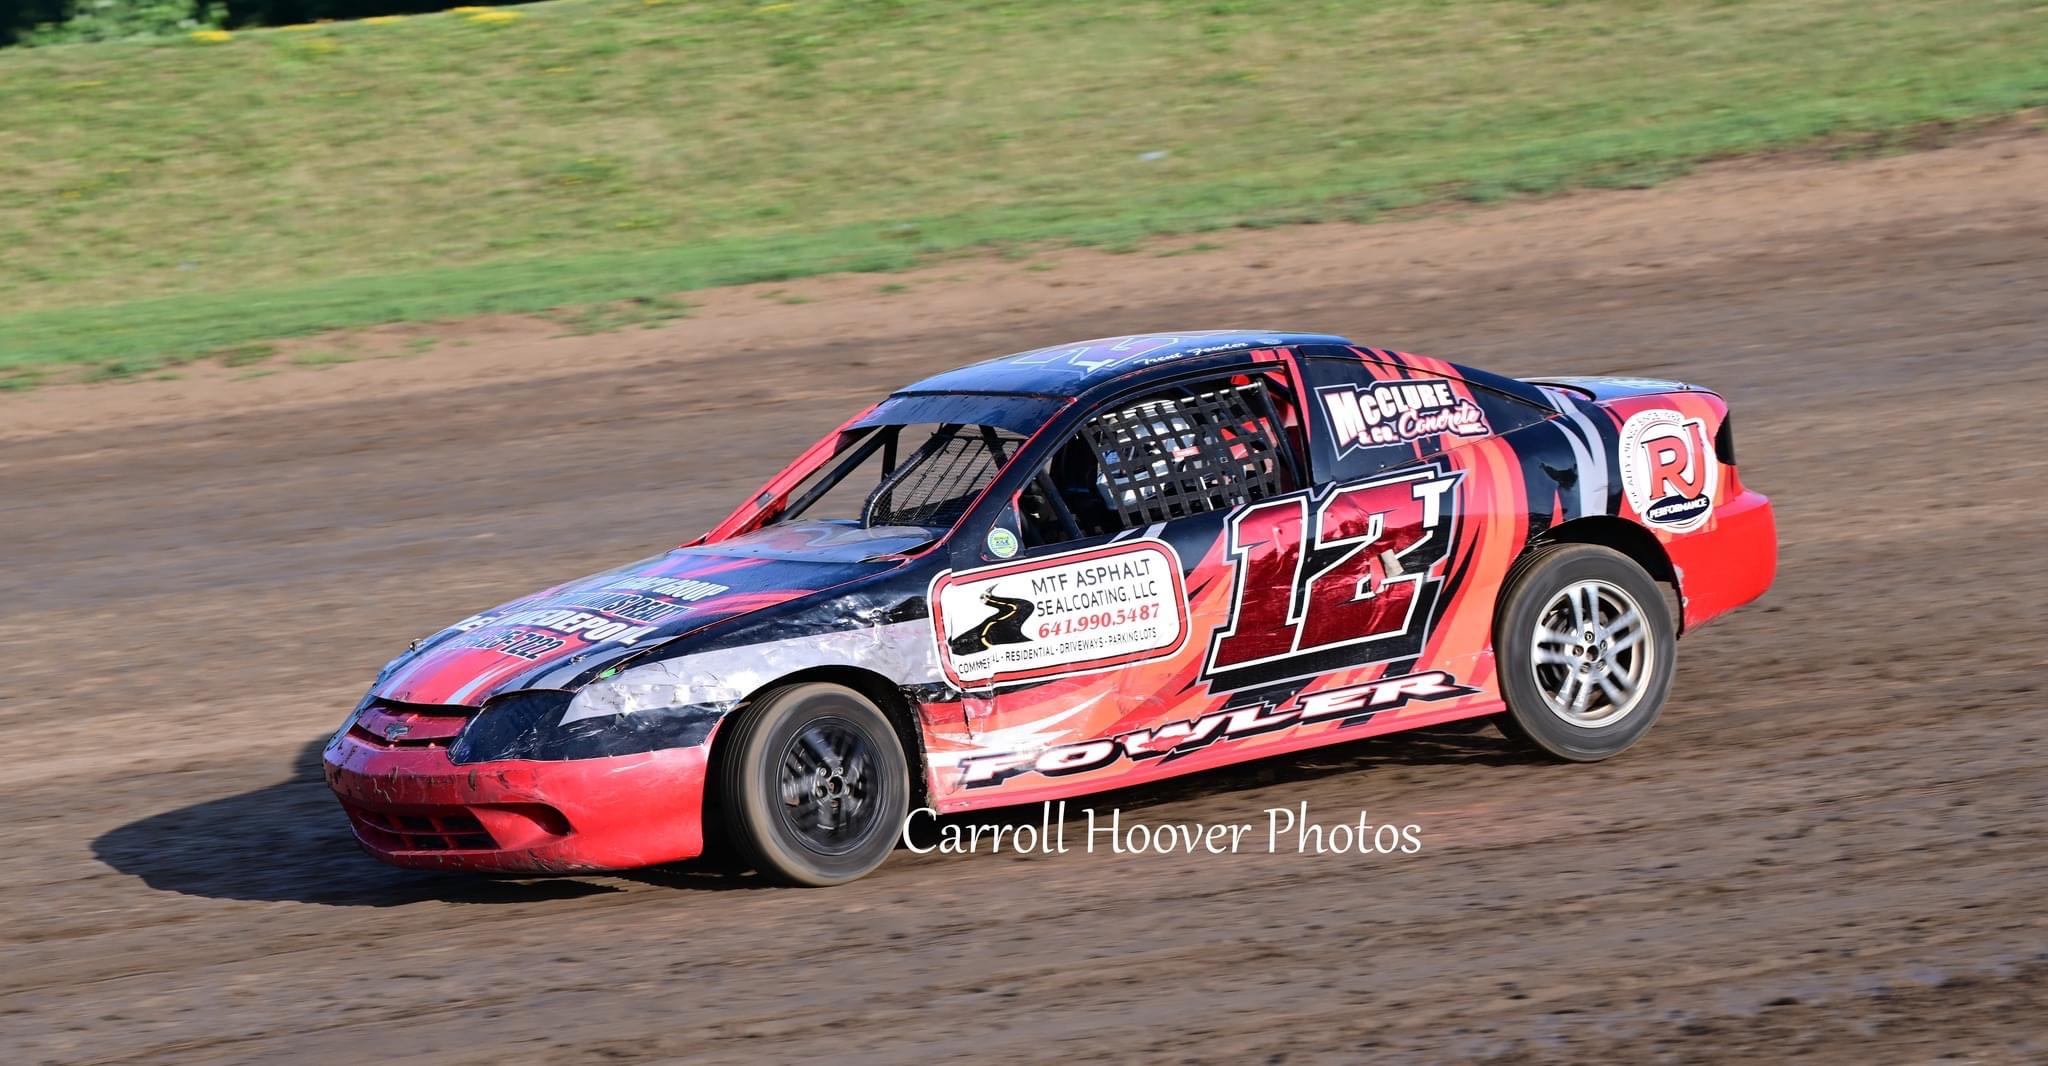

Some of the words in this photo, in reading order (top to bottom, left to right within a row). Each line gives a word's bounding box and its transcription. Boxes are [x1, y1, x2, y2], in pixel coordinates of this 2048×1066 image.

[1640, 421, 1706, 501] RJ
[1649, 497, 1708, 520] PERFORMANCE
[652, 577, 730, 602] GROUP
[1031, 570, 1068, 596] MTF
[1076, 558, 1151, 587] ASPHALT
[1133, 580, 1158, 599] LLC
[1037, 602, 1161, 640] 641.990.5487
[1005, 645, 1055, 662] RESIDENTIAL
[1059, 636, 1104, 654] DRIVEWAYS
[1109, 630, 1139, 646] PARKING
[1140, 626, 1158, 641] LOTS
[958, 669, 1472, 788] FOWLER
